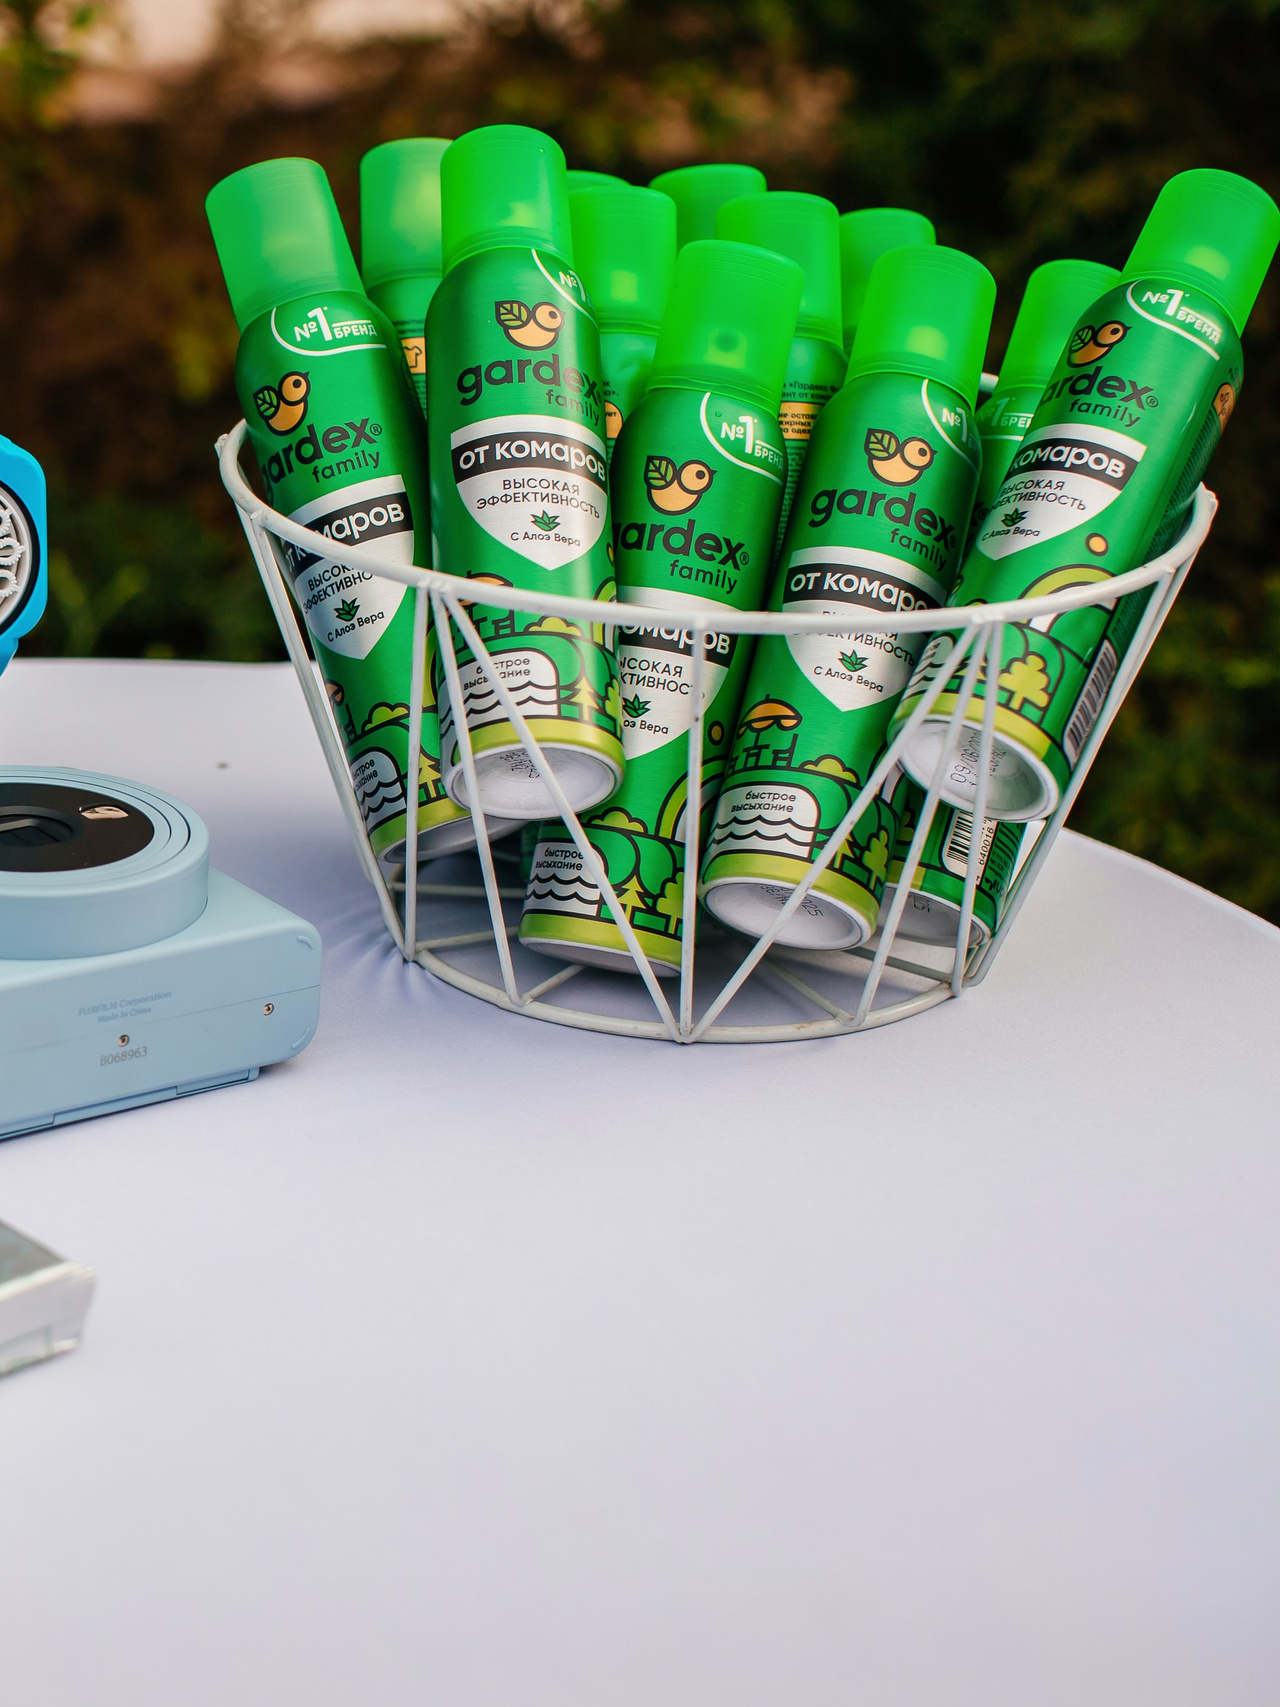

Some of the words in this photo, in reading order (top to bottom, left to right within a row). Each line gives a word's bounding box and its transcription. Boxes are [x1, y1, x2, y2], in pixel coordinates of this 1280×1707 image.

[334, 324, 378, 340] БРЕНД
[1176, 310, 1222, 345] БРЕНД
[546, 389, 600, 427] family
[1069, 399, 1141, 428] family
[1000, 416, 1032, 429] БРЕ
[312, 450, 380, 484] family
[503, 478, 580, 496] ВЫСОКАЯ
[476, 491, 601, 519] ЭФФЕКТИВНОСТЬ
[510, 532, 519, 541] С
[523, 531, 550, 541] Алоэ
[554, 533, 581, 546] Вера
[1012, 527, 1041, 537] Вера
[890, 528, 947, 572] family
[307, 563, 356, 592] ВЫСОК
[670, 560, 738, 594] family
[335, 623, 356, 640] Алоэ
[357, 611, 385, 628] Вера
[476, 658, 530, 675] бстрое
[620, 657, 683, 678] ЫСОКАЯ
[814, 666, 822, 675] С
[825, 668, 853, 681] Алоэ
[856, 675, 884, 693] Вера
[639, 720, 669, 735] Вера
[731, 802, 794, 813] высыхание
[745, 790, 797, 802] быстрое
